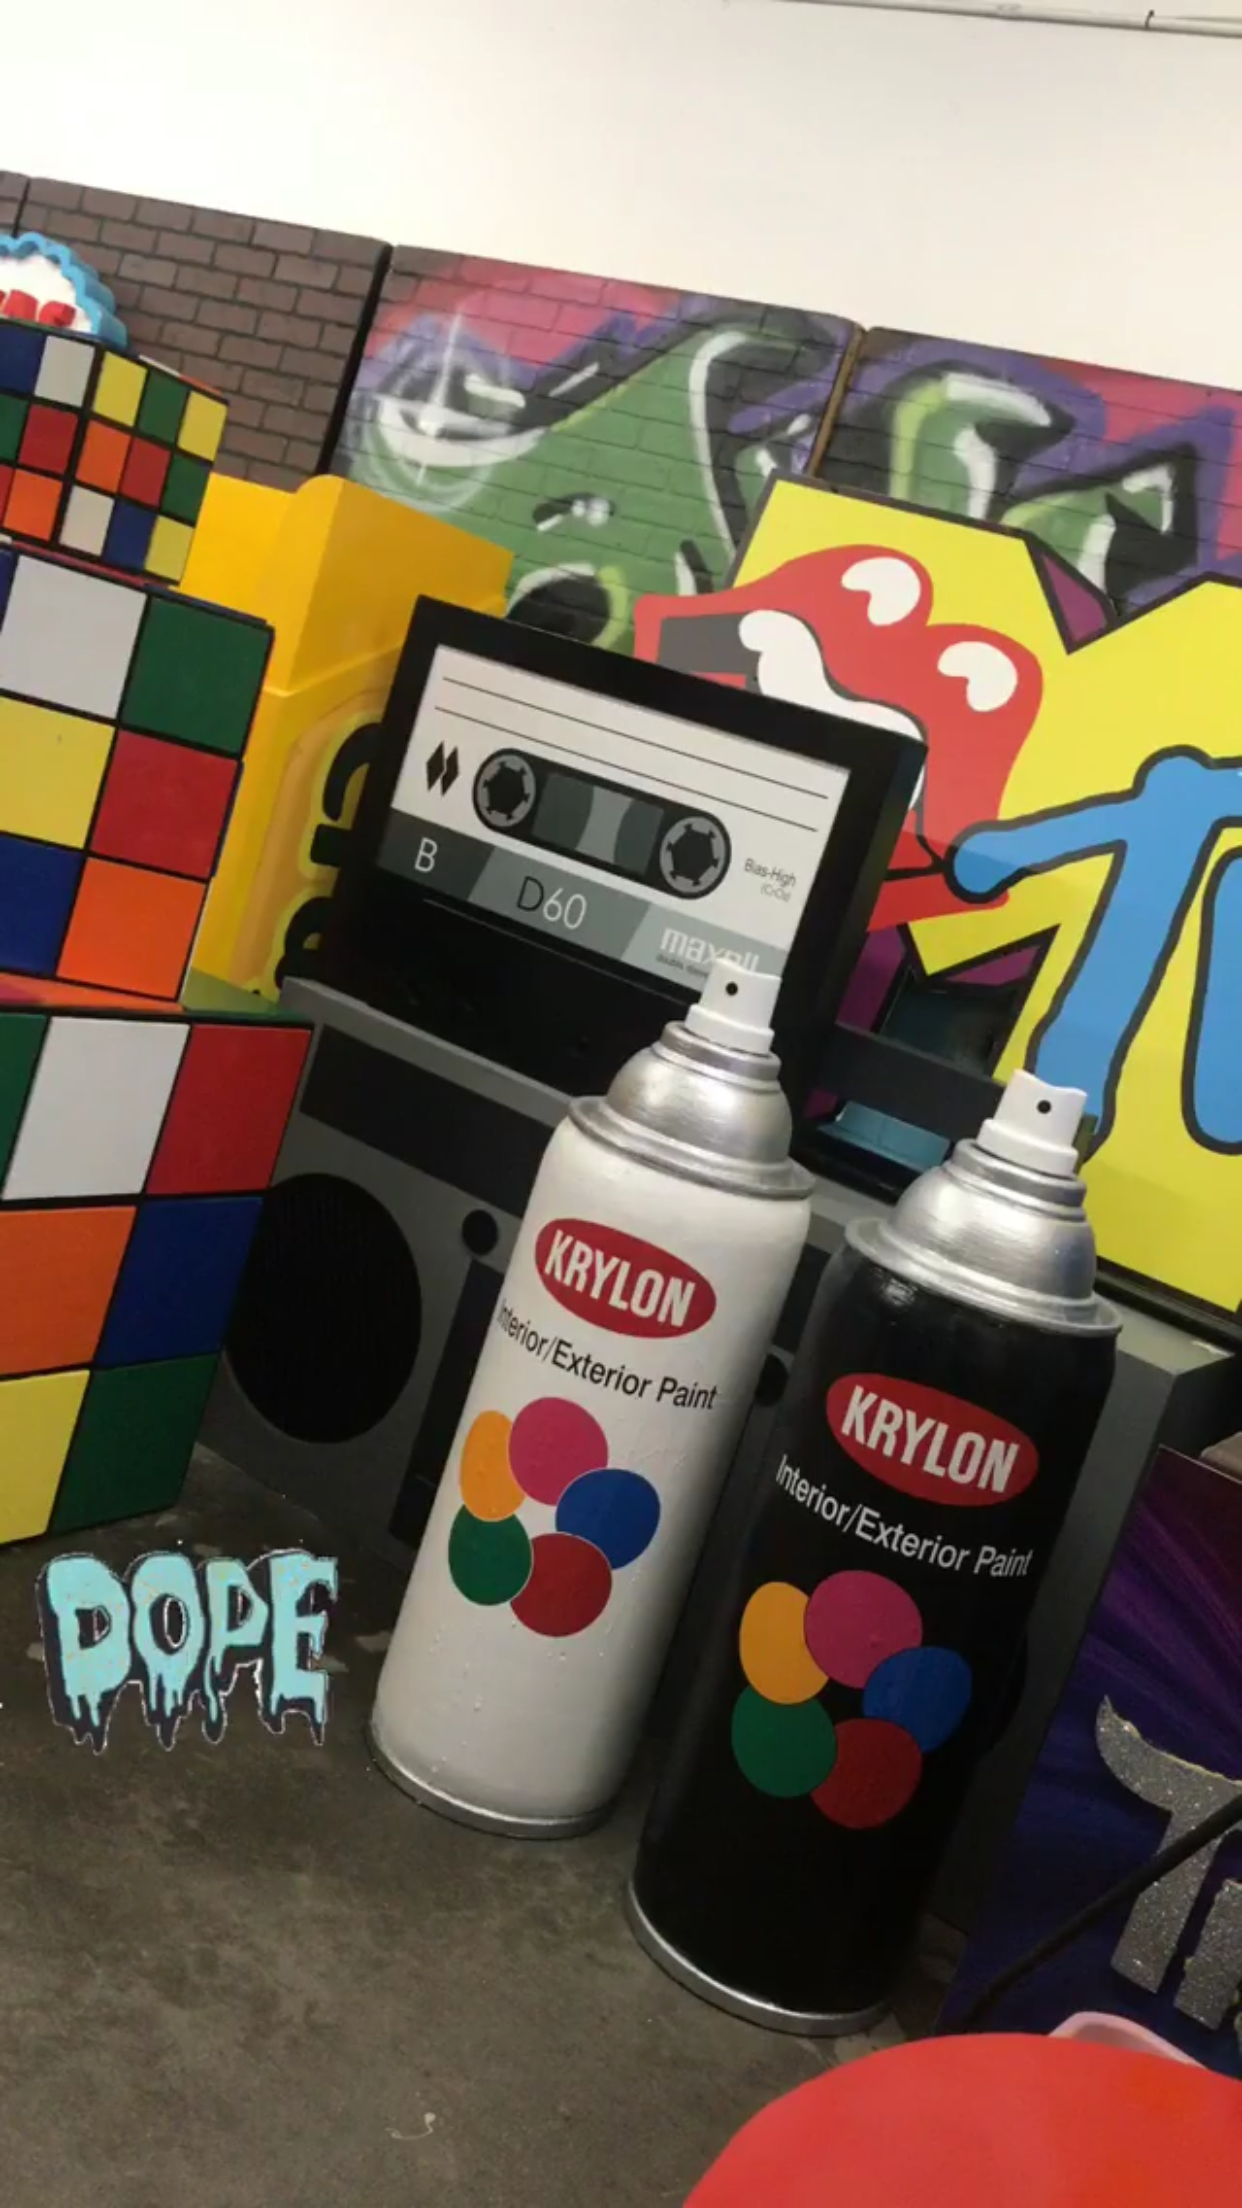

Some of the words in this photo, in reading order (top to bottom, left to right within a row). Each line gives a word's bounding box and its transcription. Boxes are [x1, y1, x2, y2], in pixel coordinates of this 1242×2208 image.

[414, 837, 438, 872] B
[516, 876, 588, 930] D60
[544, 1229, 696, 1328] KRYLON
[496, 1298, 654, 1400] Interior/Exterior
[655, 1376, 718, 1411] Paint
[841, 1385, 1021, 1494] KRYLON
[775, 1453, 970, 1572] Interior/Exterior
[972, 1545, 1034, 1578] Paint
